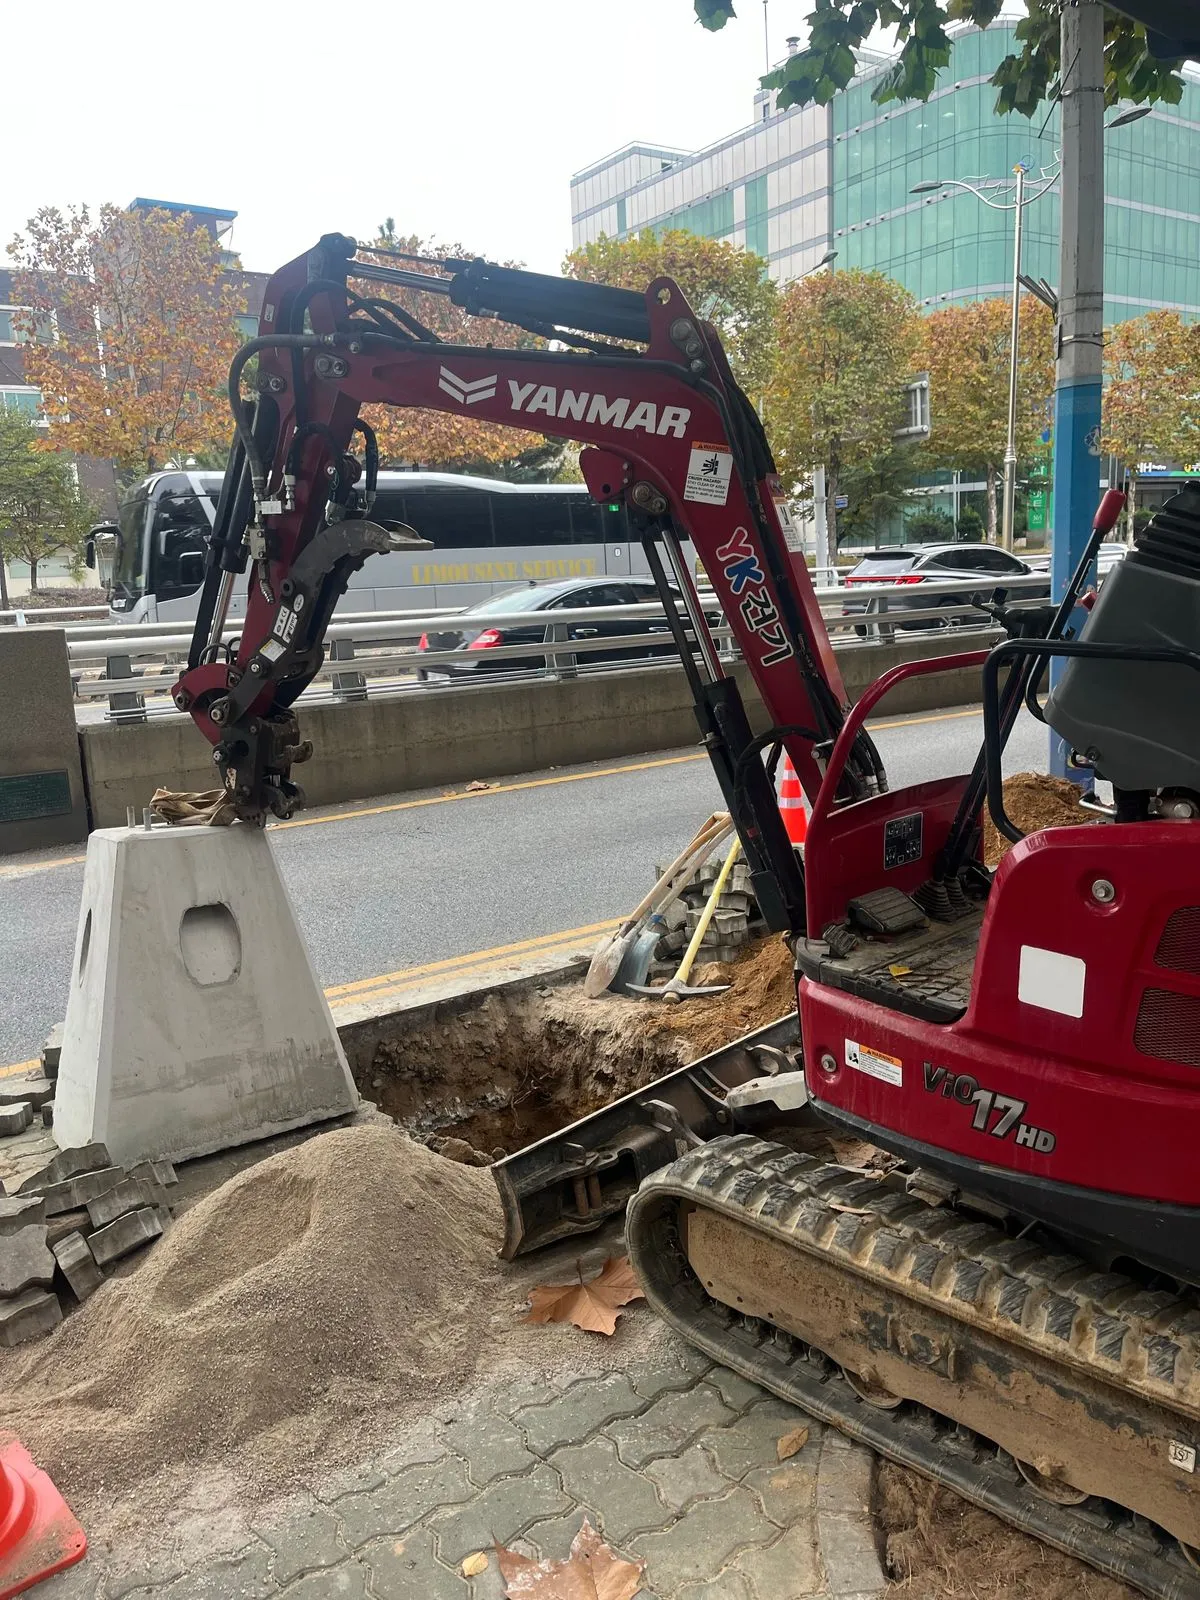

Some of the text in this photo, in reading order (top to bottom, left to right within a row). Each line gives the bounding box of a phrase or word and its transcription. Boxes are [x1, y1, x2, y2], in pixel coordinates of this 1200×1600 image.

[507, 379, 692, 439] YANMAR
[411, 557, 597, 585] LIMOUSINE SERVICE
